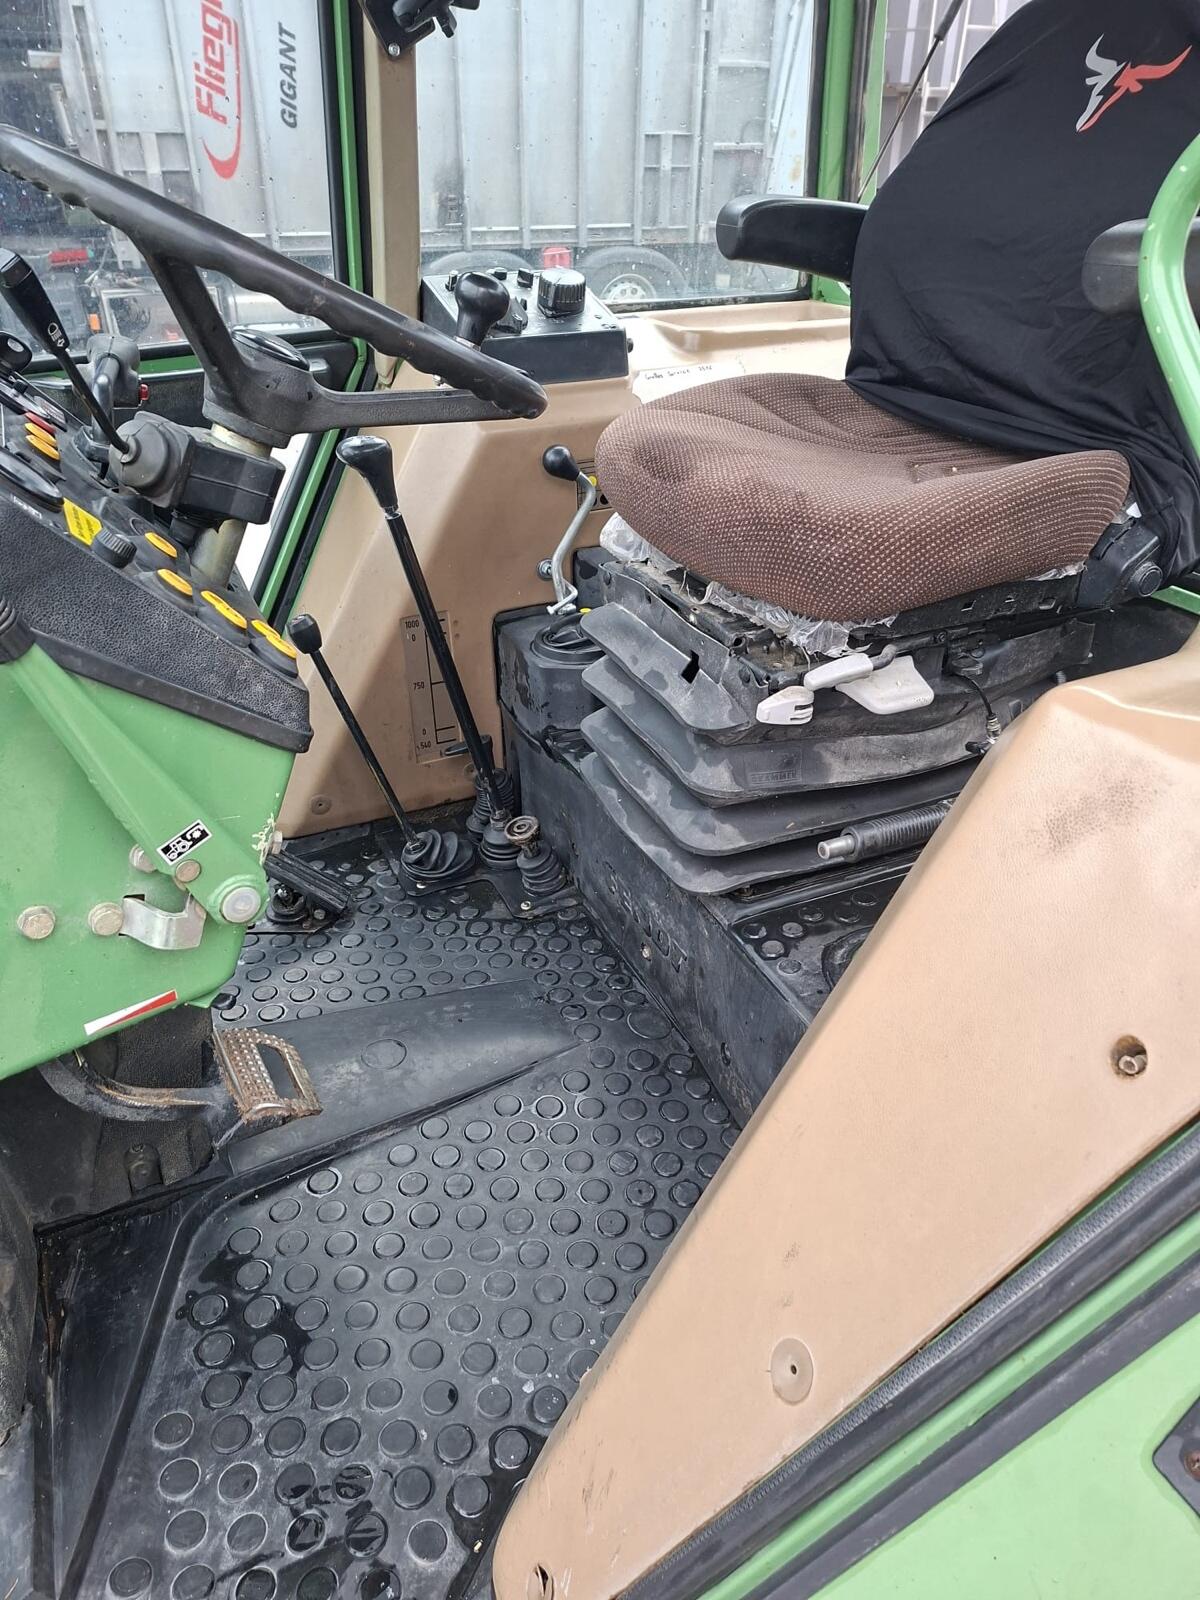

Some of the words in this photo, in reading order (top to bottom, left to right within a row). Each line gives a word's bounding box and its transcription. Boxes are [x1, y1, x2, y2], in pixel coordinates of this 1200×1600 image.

[279, 21, 298, 128] GIGANT
[405, 619, 419, 630] 1000
[411, 634, 416, 642] 0
[413, 681, 425, 690] 750
[422, 728, 427, 736] 0
